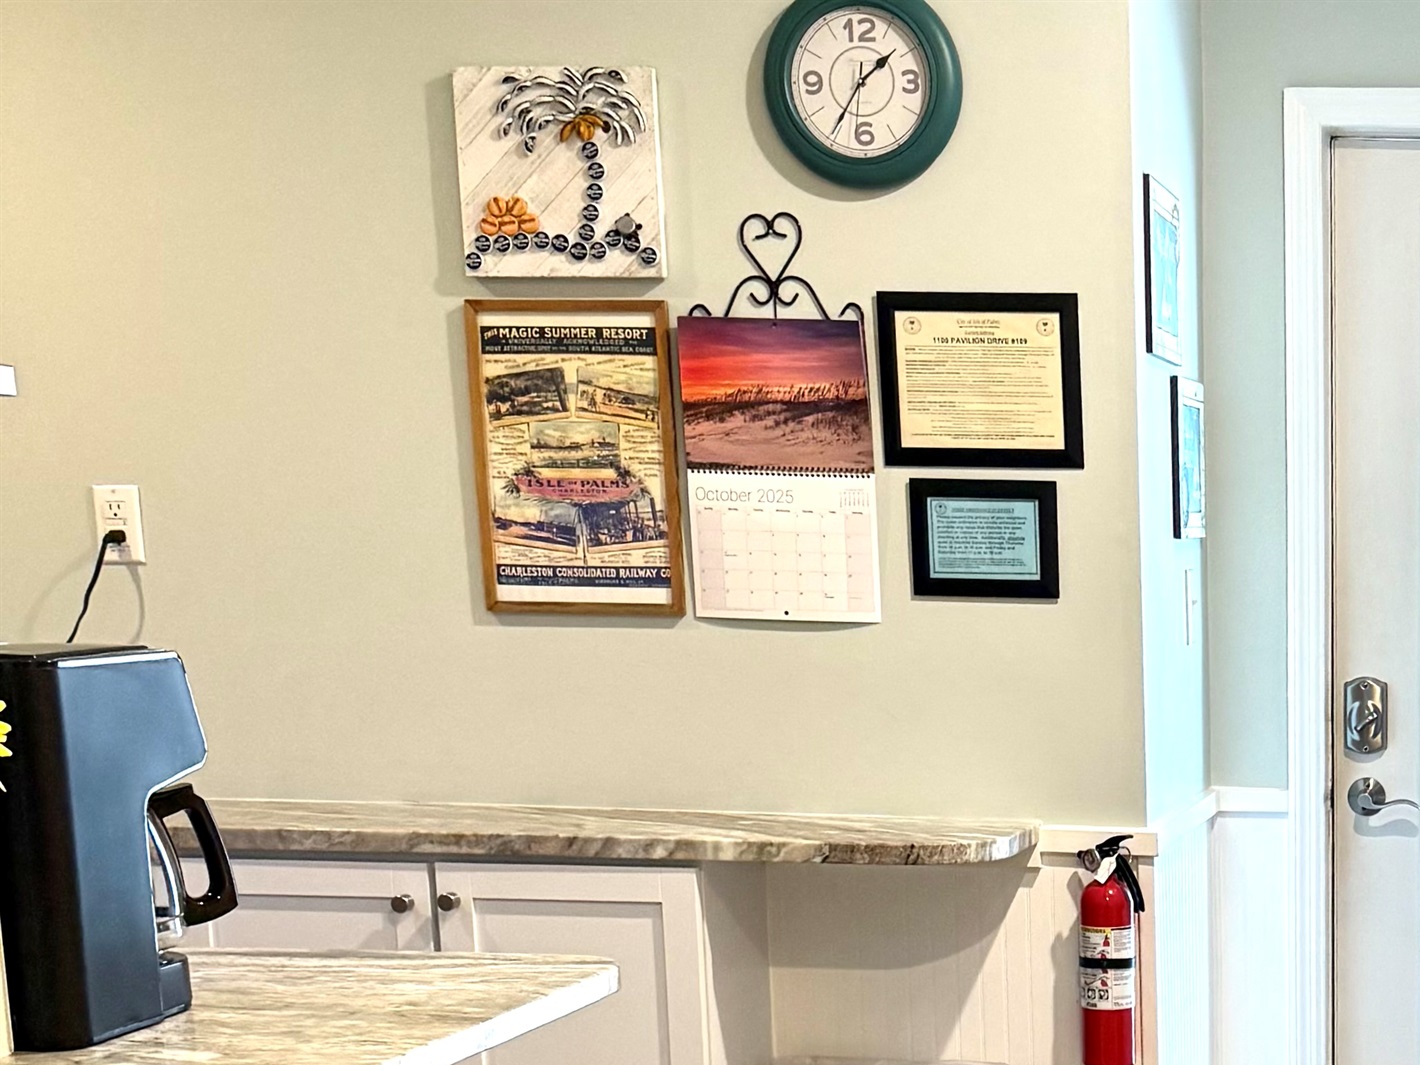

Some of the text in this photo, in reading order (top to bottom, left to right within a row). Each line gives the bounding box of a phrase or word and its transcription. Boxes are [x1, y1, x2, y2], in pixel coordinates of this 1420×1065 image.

[842, 17, 876, 43] 12
[802, 70, 823, 95] 9
[901, 69, 920, 94] 3
[854, 121, 875, 146] 6
[499, 327, 540, 338] MAGIC
[544, 328, 596, 339] SUMMER
[603, 328, 648, 339] RESORT
[987, 337, 1009, 345] DRIVE
[527, 479, 565, 488] ISLE
[581, 480, 629, 489] PALMS
[695, 486, 794, 504] October 2025
[499, 566, 553, 577] CHARLESTON
[556, 567, 617, 578] CONSOLIDATED
[620, 568, 657, 578] RAILWAY
